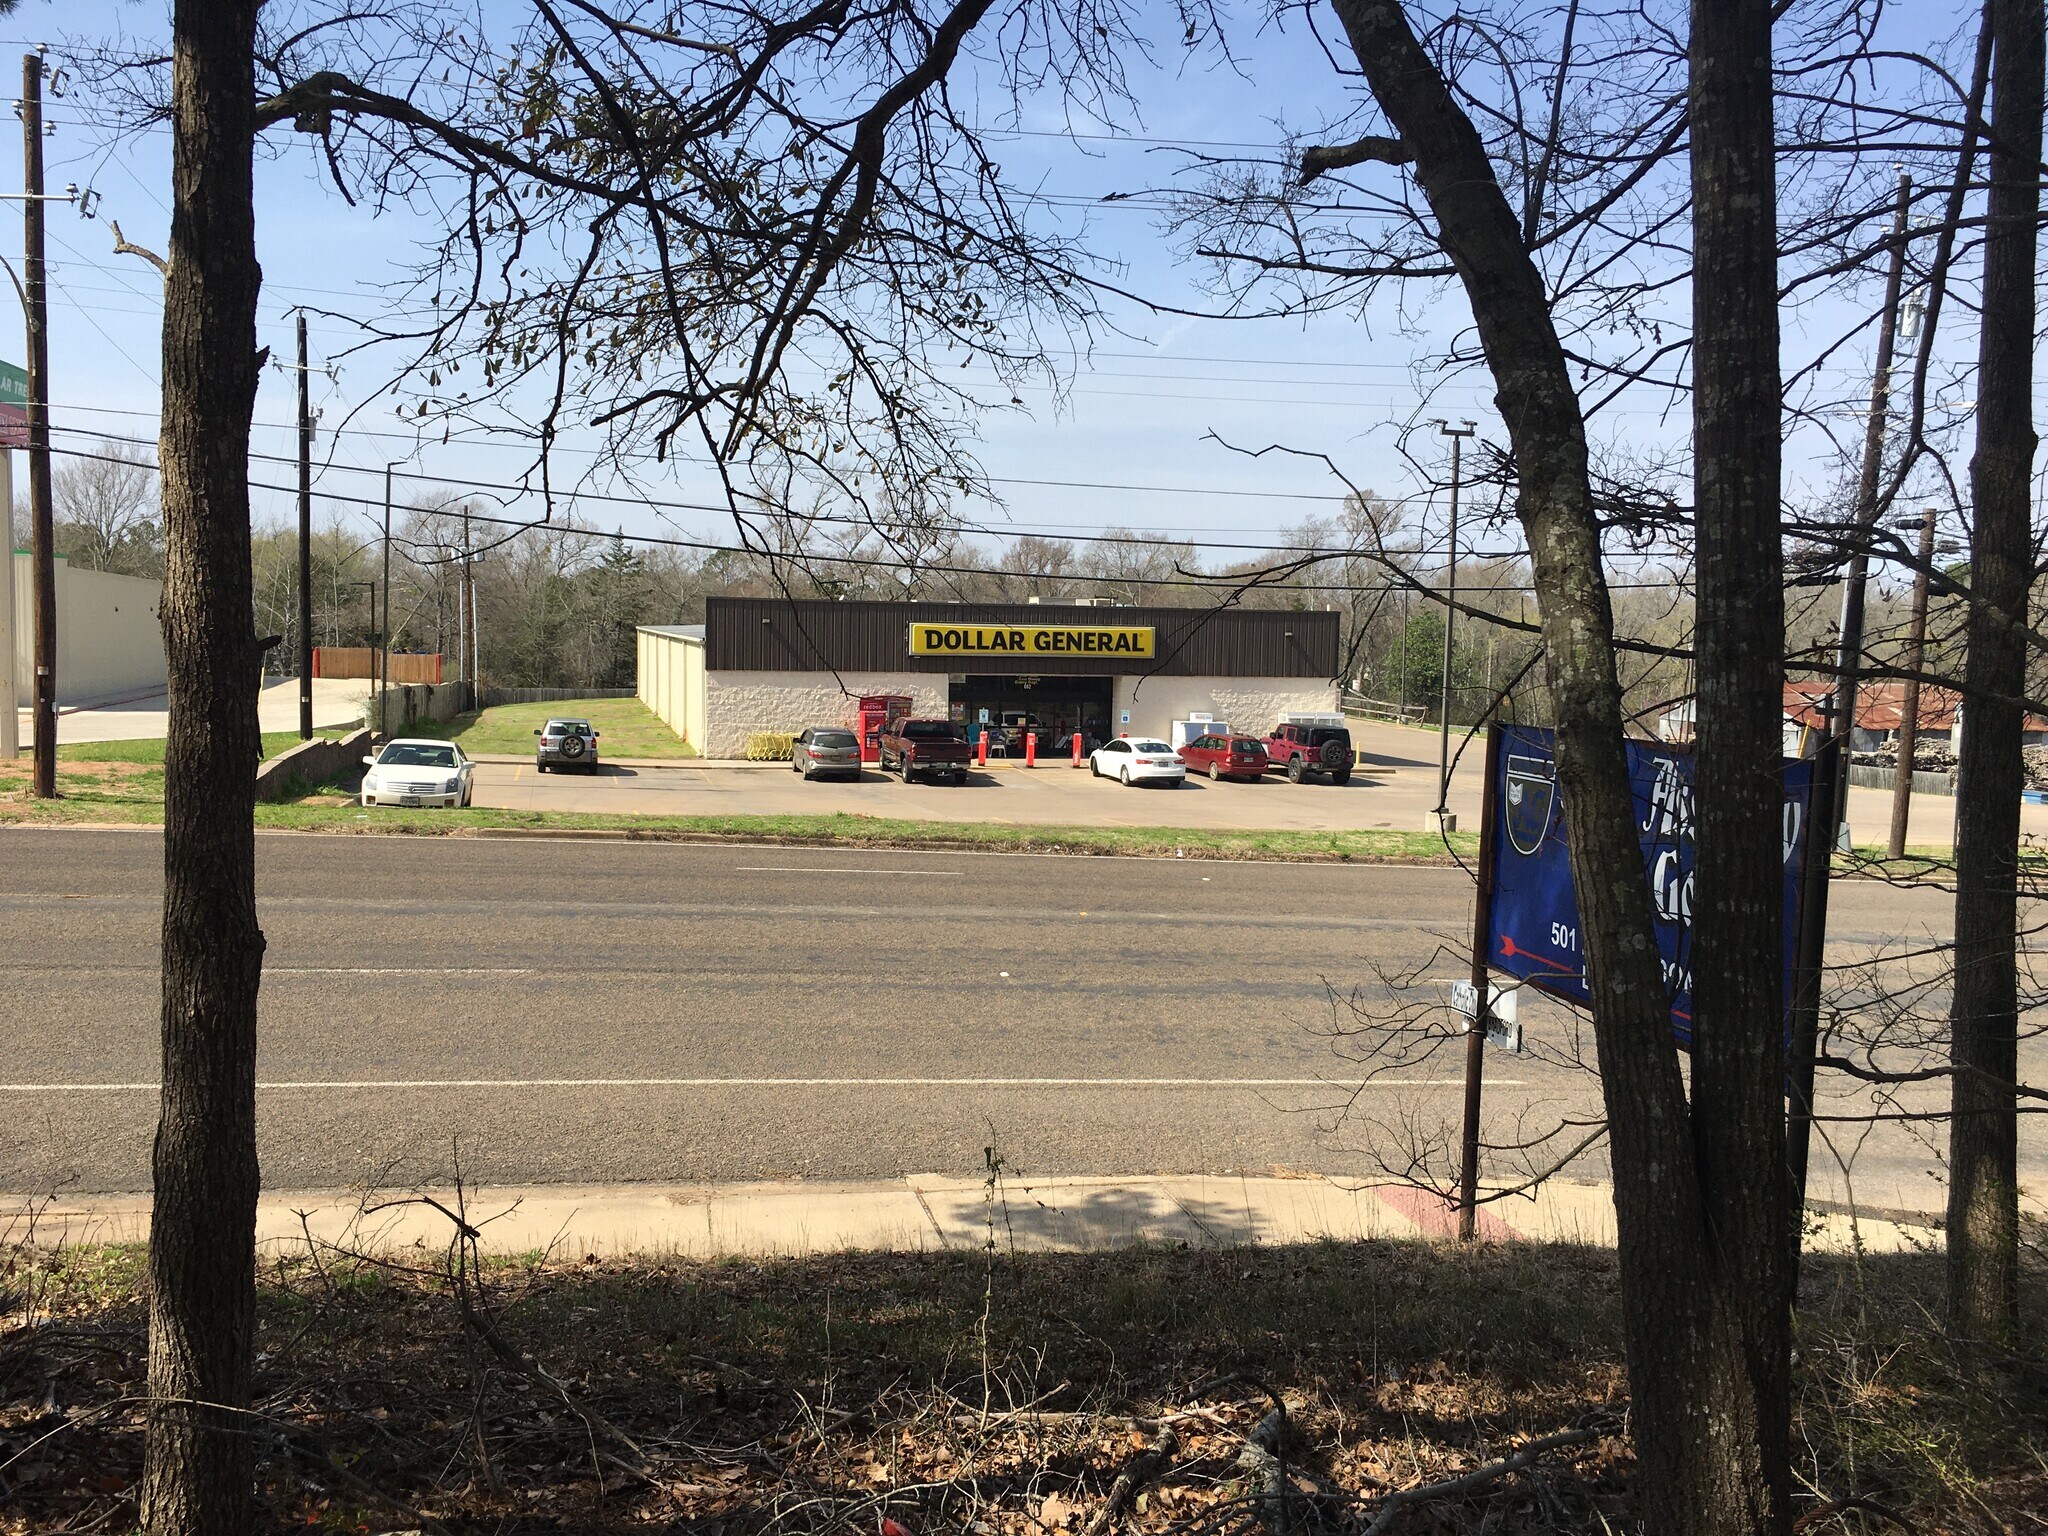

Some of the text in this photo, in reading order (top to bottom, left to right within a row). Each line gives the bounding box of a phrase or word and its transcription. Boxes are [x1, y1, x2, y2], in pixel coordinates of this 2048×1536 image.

[924, 630, 1145, 652] DOLLAR GENERAL
[1551, 921, 1576, 952] 501
